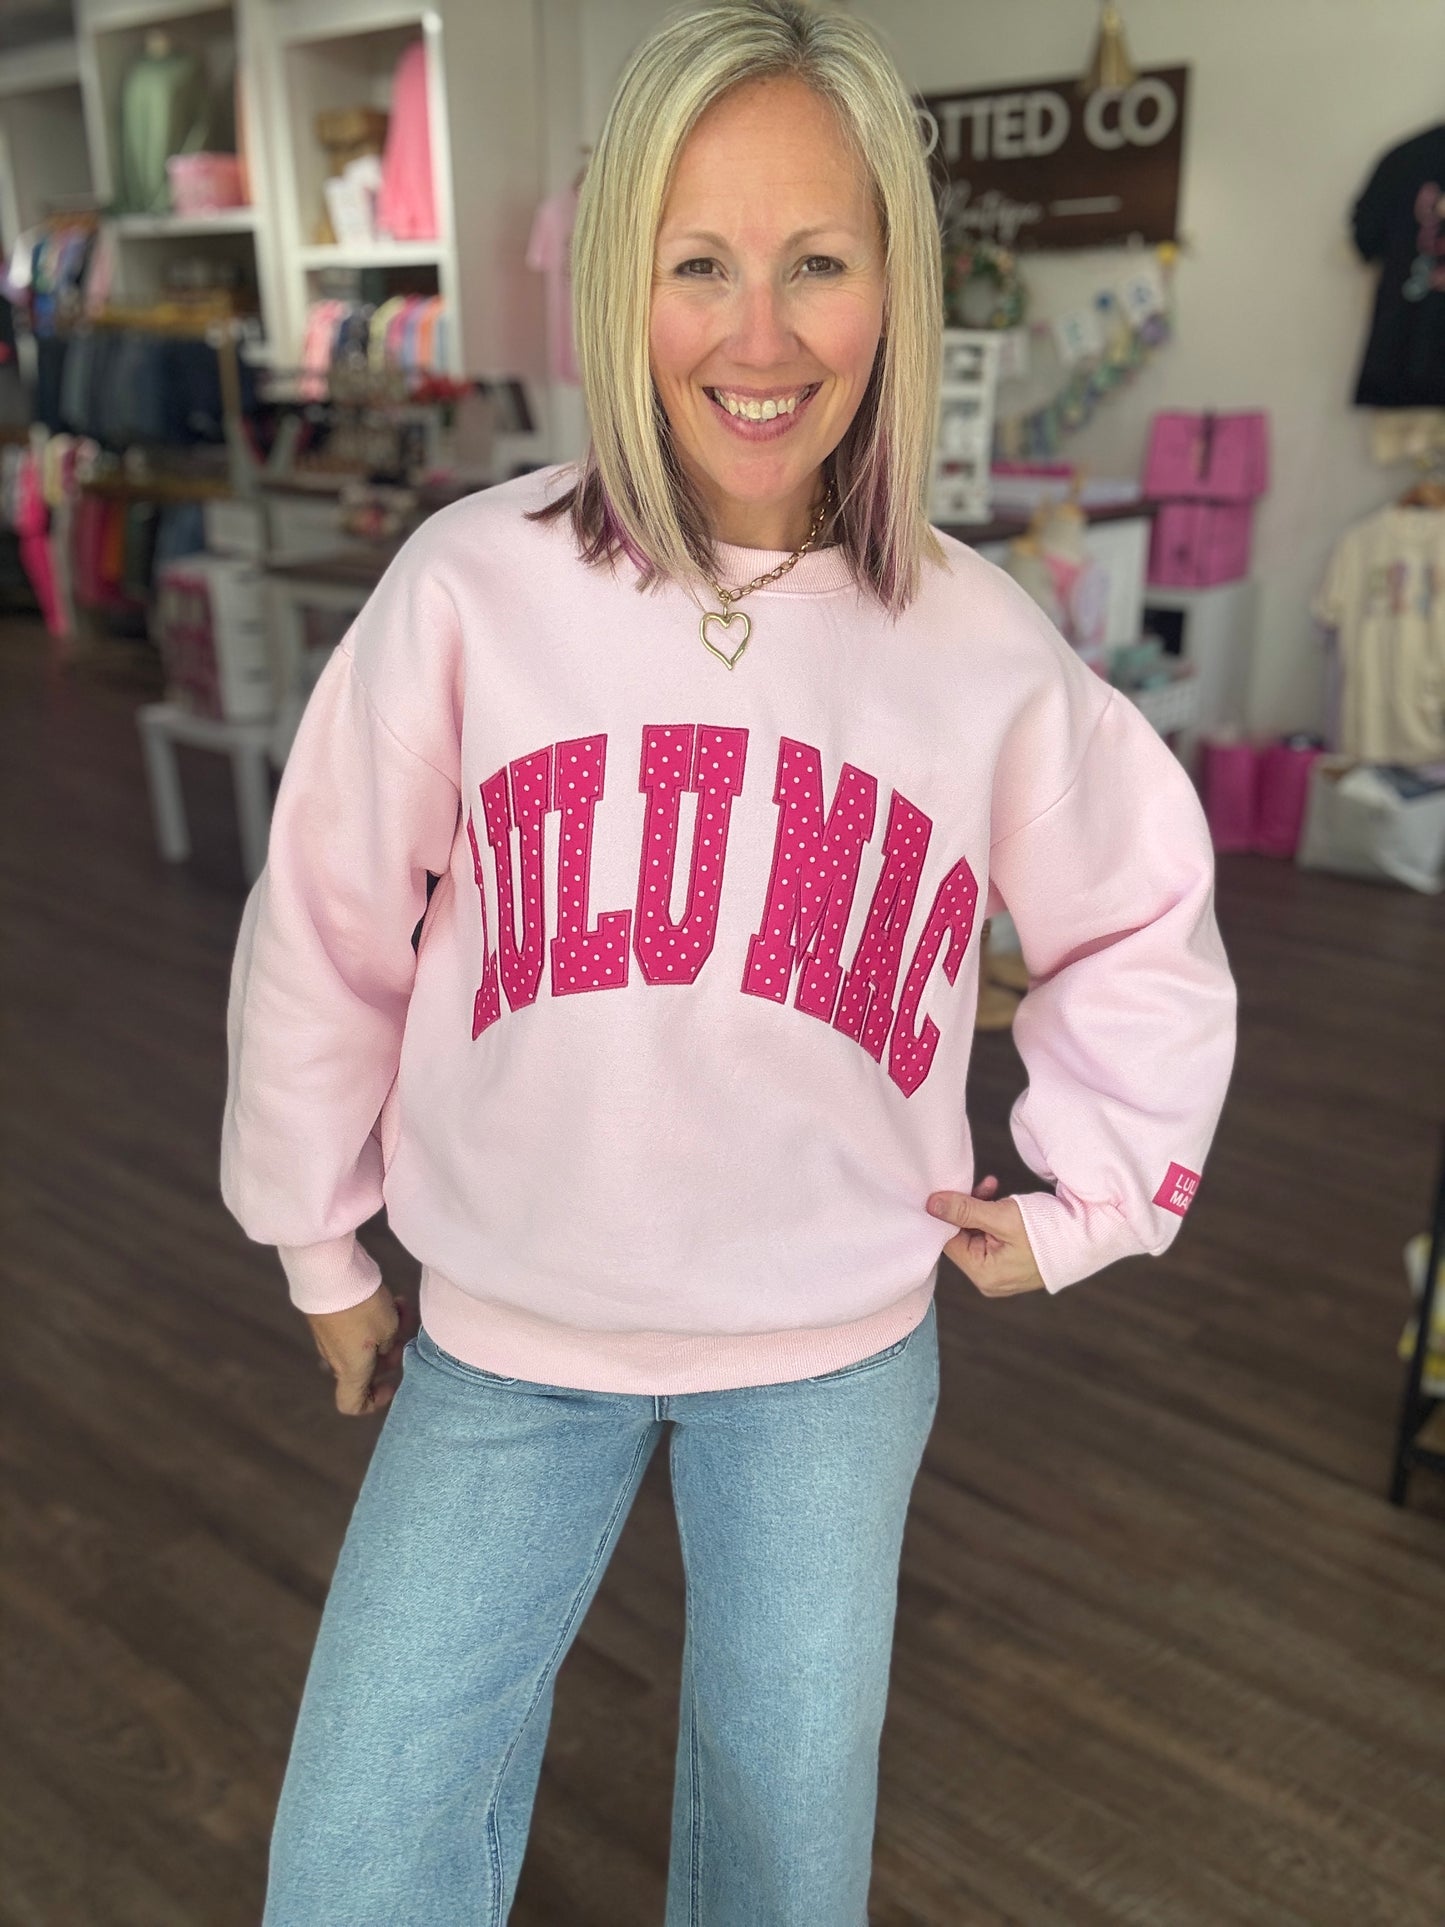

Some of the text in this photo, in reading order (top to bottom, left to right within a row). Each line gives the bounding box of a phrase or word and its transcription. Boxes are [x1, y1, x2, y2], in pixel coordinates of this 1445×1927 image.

[1083, 77, 1177, 149] CO
[741, 737, 979, 1098] MAC
[1169, 1190, 1192, 1210] MA
[1175, 1173, 1198, 1195] LUL
